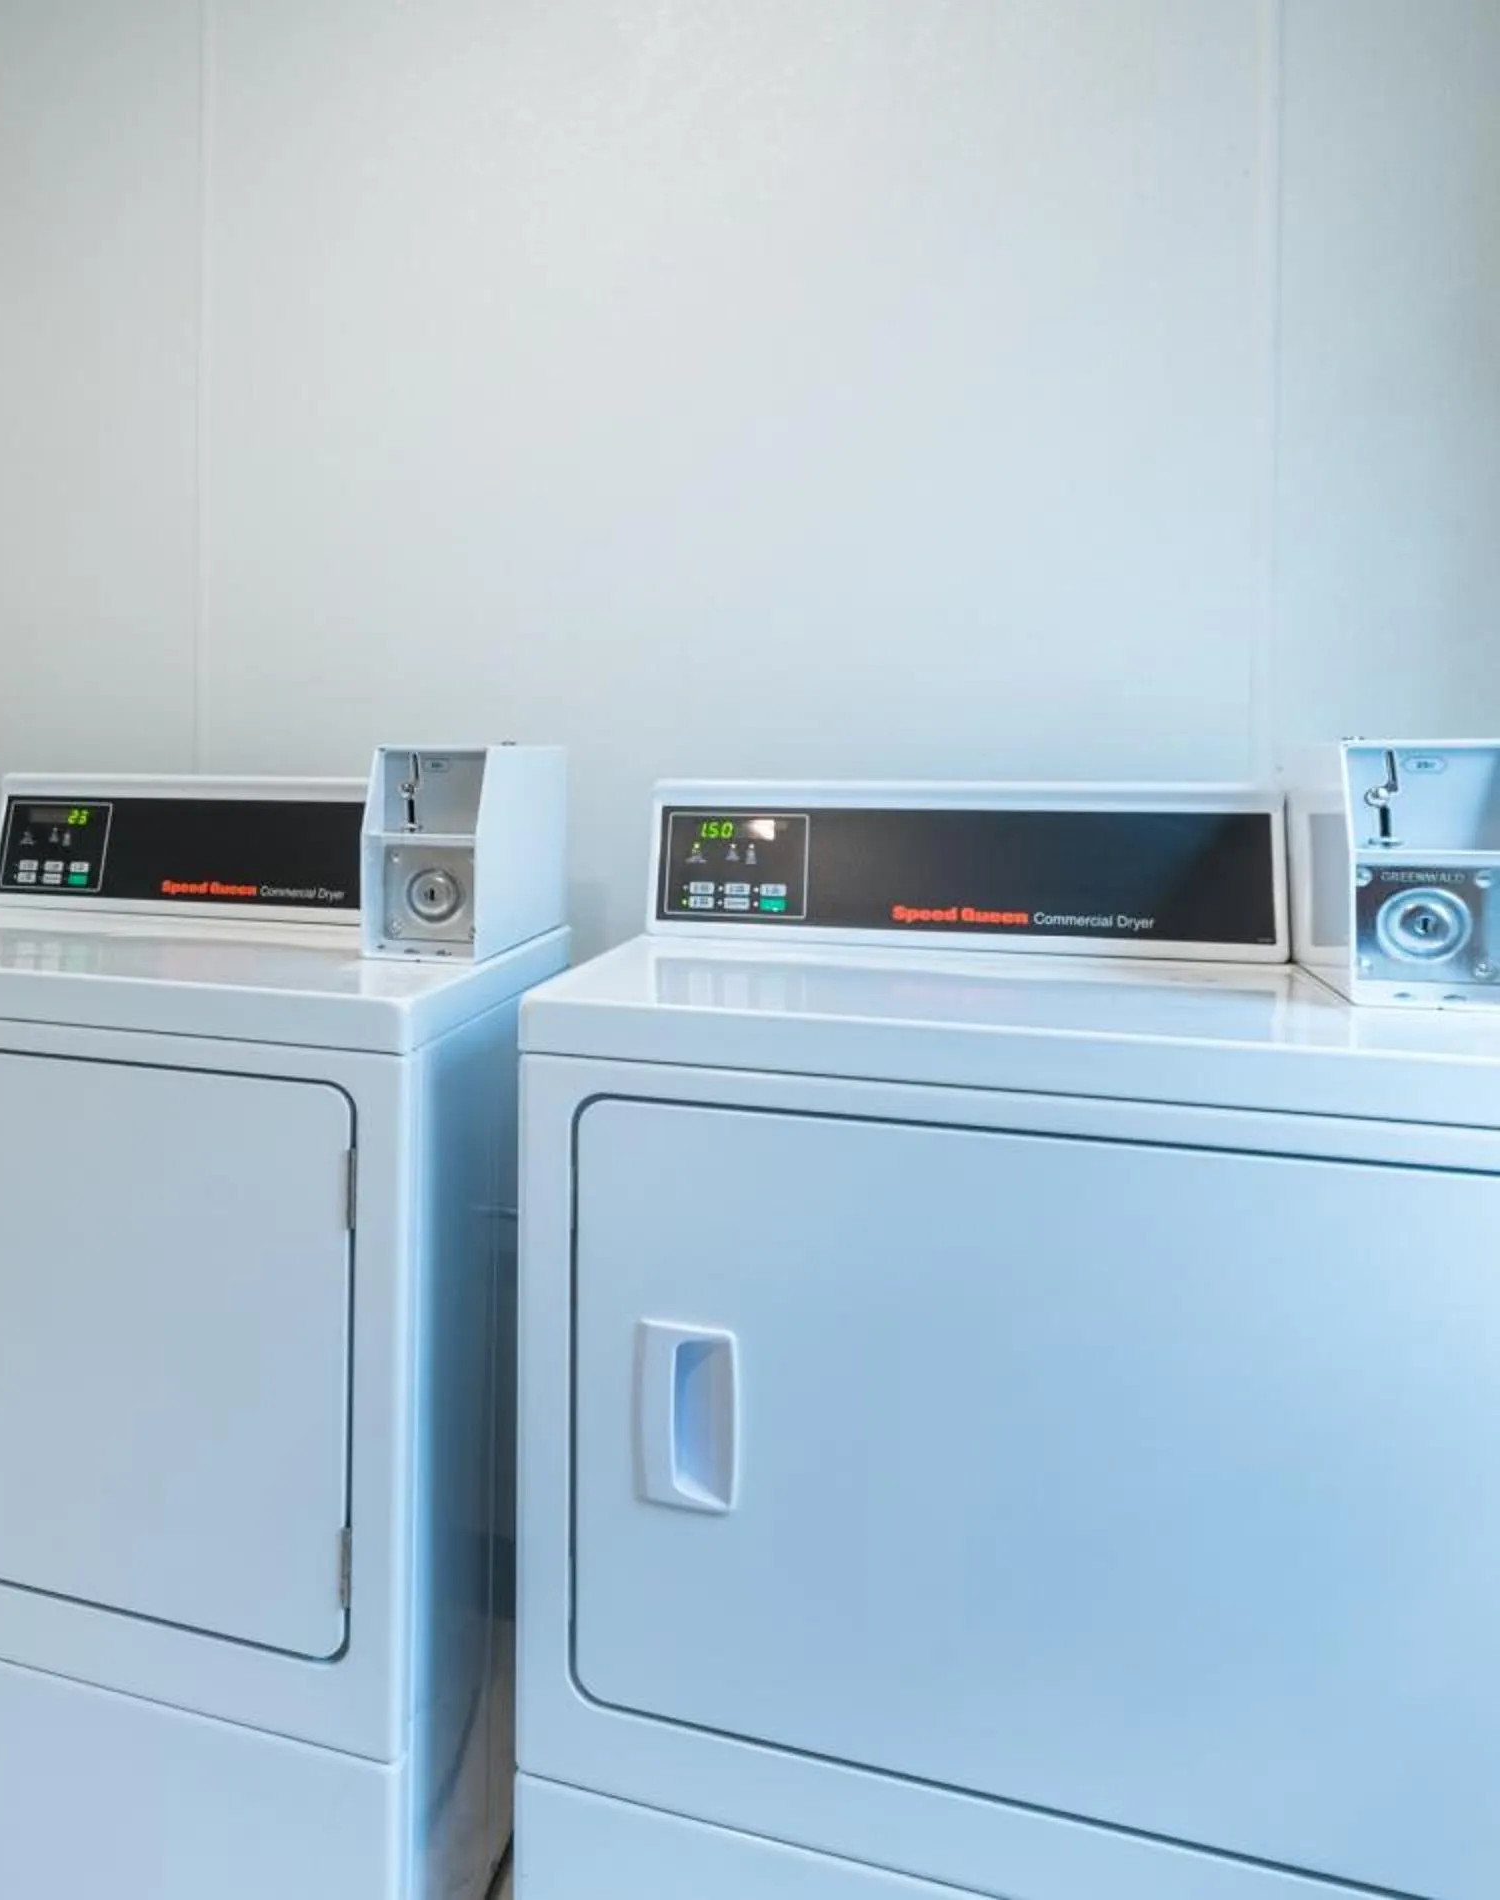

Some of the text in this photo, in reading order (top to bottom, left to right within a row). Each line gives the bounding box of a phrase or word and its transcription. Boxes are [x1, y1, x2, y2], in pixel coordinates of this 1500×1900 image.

[1380, 870, 1466, 883] GREENWALD
[162, 880, 345, 901] Speed Queen Commercial Dryer
[892, 905, 1155, 931] Speed Queen Commercial Dryer
